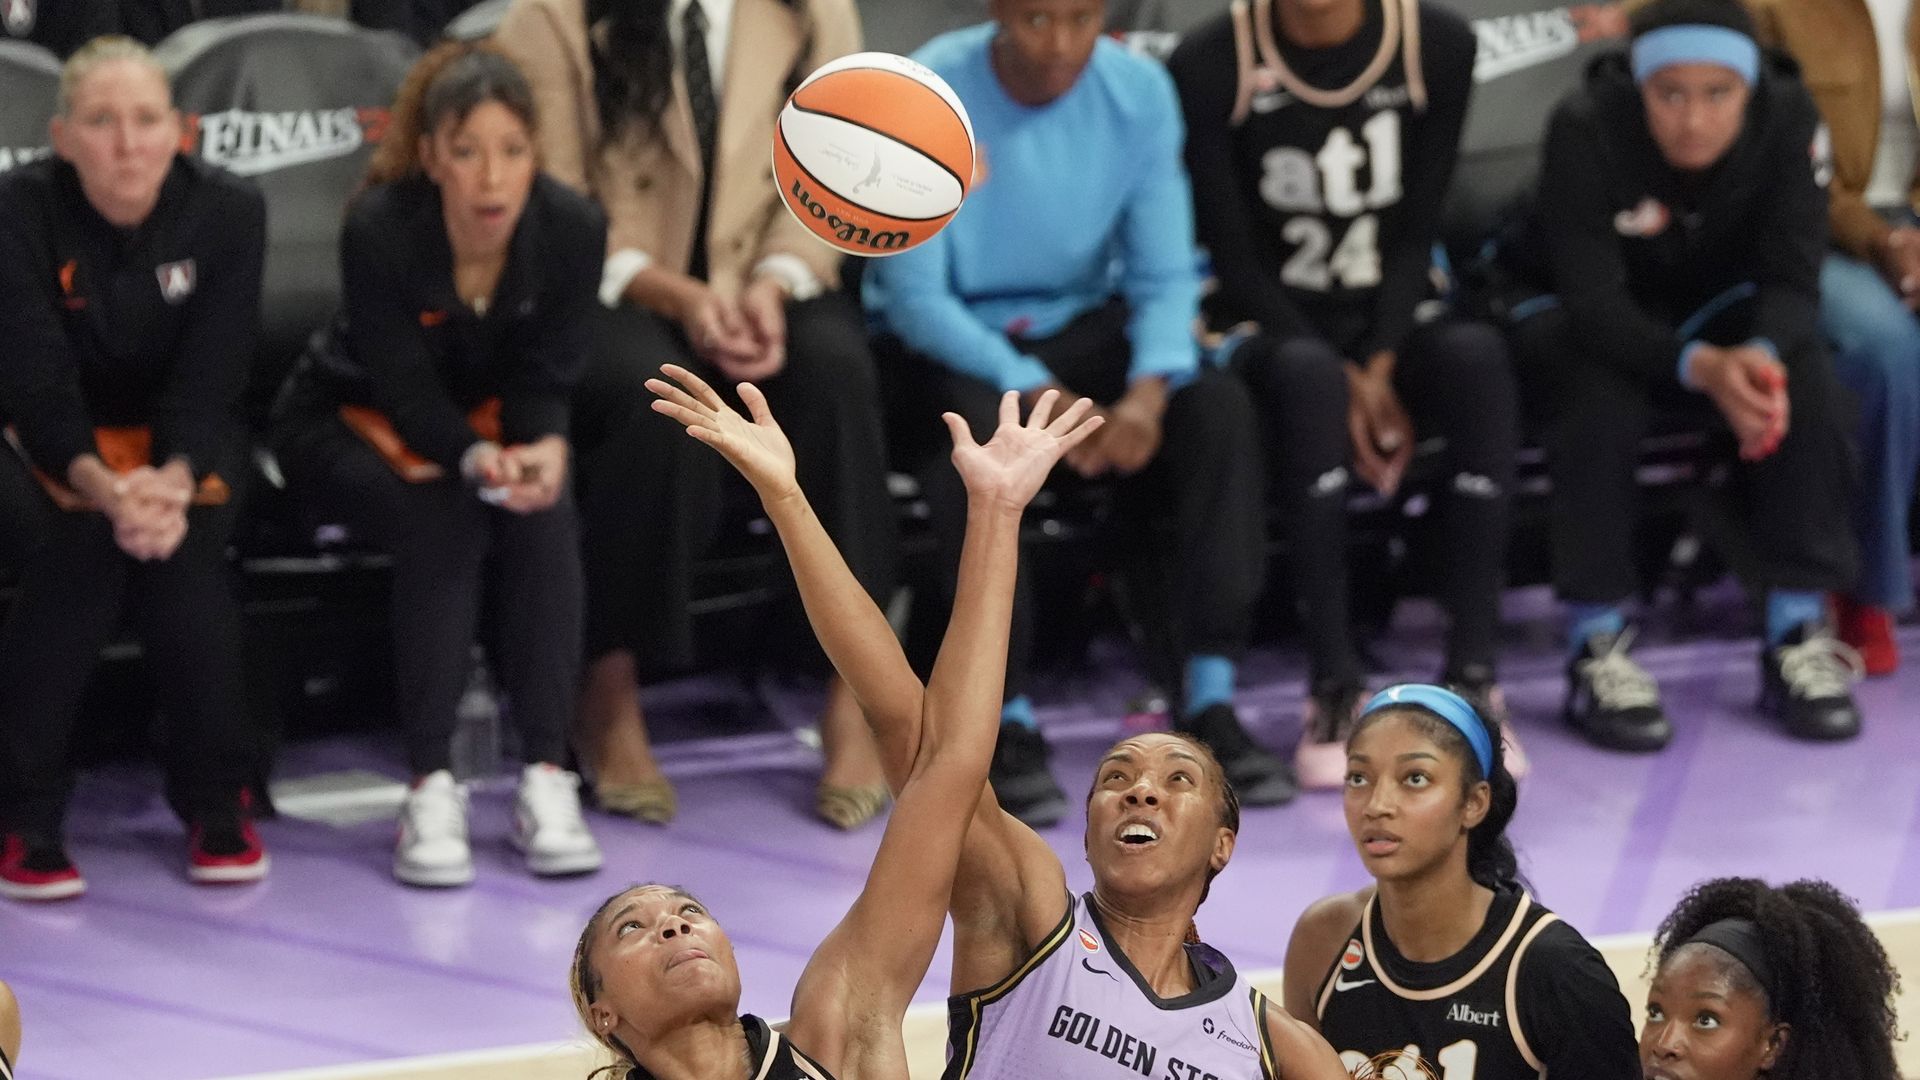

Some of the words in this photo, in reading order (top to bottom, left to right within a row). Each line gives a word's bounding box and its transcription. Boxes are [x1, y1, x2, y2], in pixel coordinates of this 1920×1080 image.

[791, 179, 910, 249] Wilson
[1280, 215, 1382, 291] 24
[1048, 1005, 1157, 1077] GOLDEN
[1217, 1030, 1257, 1051] freedom
[1446, 1003, 1500, 1027] Albert
